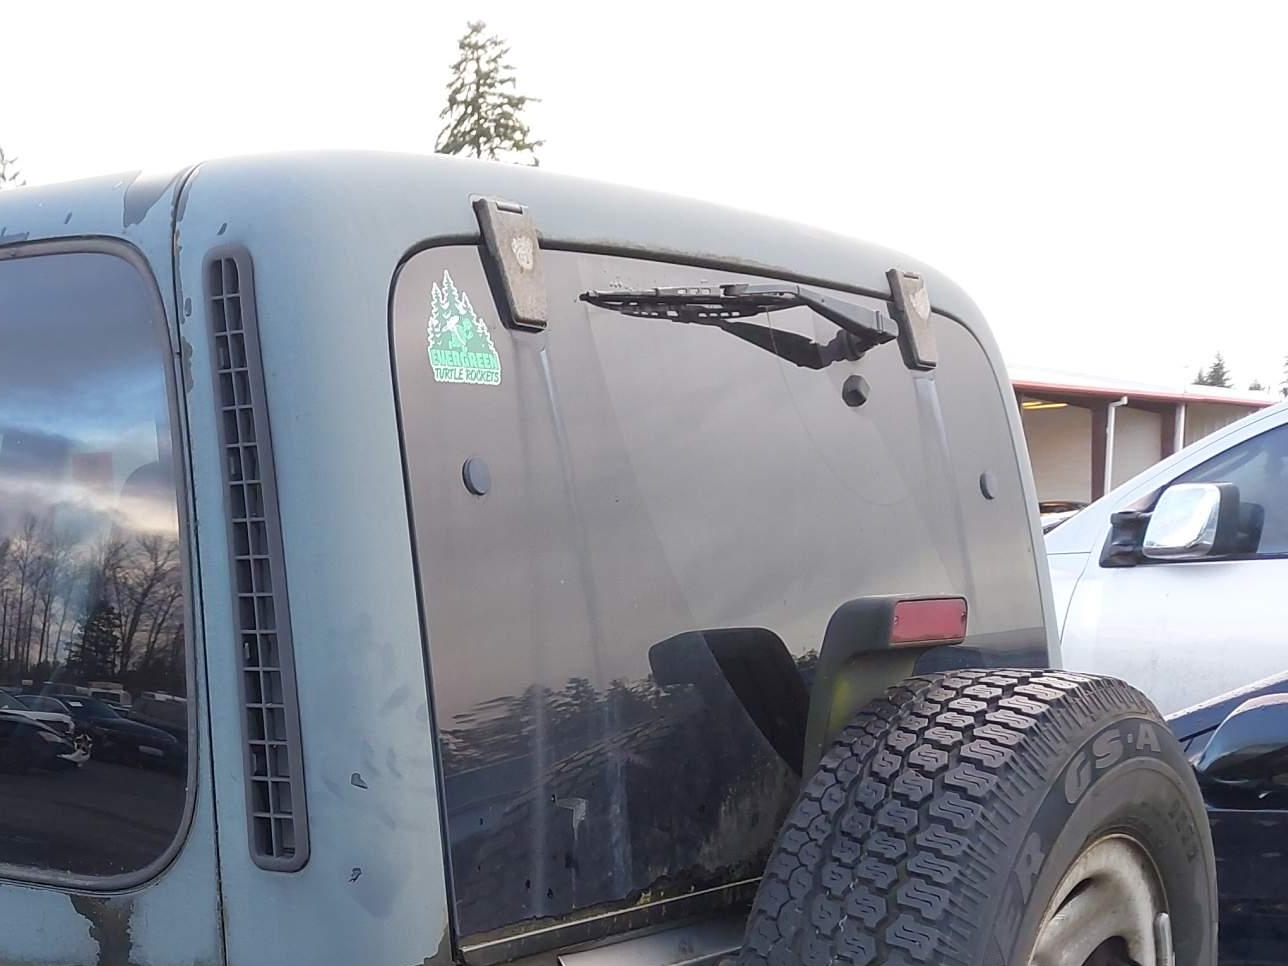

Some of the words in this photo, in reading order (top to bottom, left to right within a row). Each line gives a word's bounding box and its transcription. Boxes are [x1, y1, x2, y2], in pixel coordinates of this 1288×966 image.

[431, 349, 498, 369] EVERGREEN
[435, 368, 464, 380] TURTLE
[466, 370, 499, 383] ROCKETS
